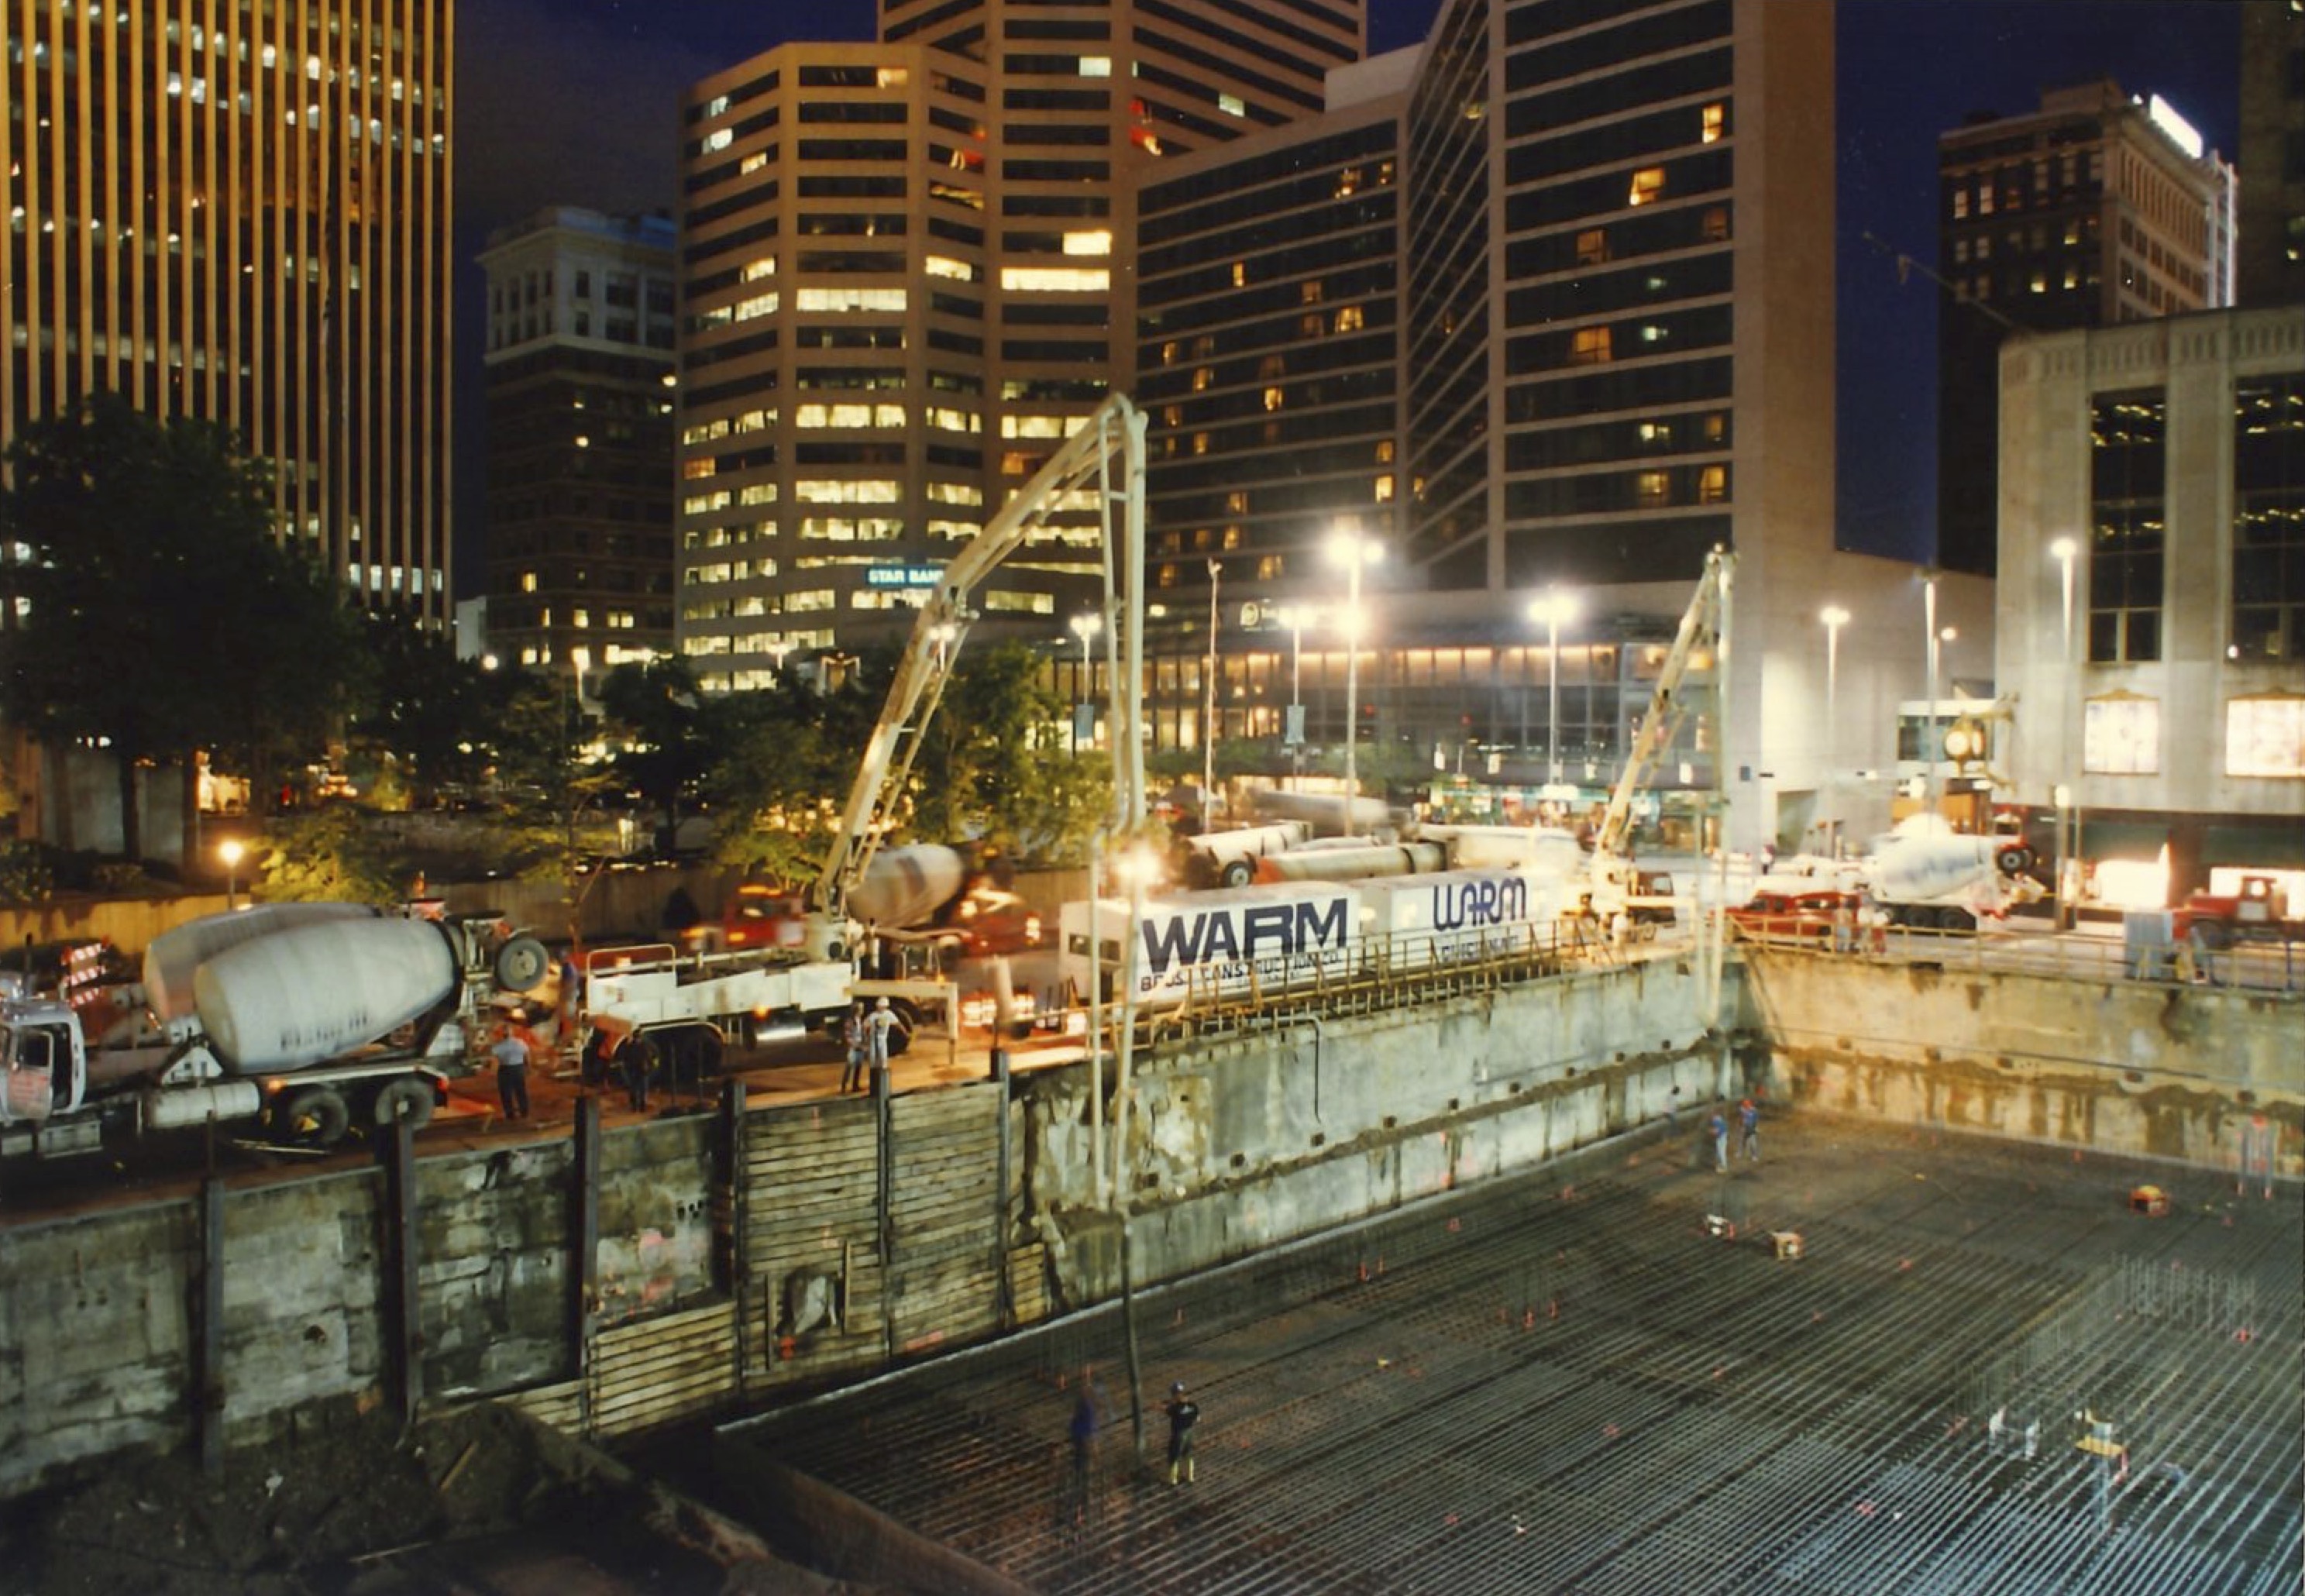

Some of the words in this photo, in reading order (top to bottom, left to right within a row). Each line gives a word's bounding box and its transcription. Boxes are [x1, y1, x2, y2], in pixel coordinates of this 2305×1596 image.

[869, 569, 904, 584] STAR
[1434, 876, 1526, 932] WARM
[1142, 898, 1348, 974] WARM
